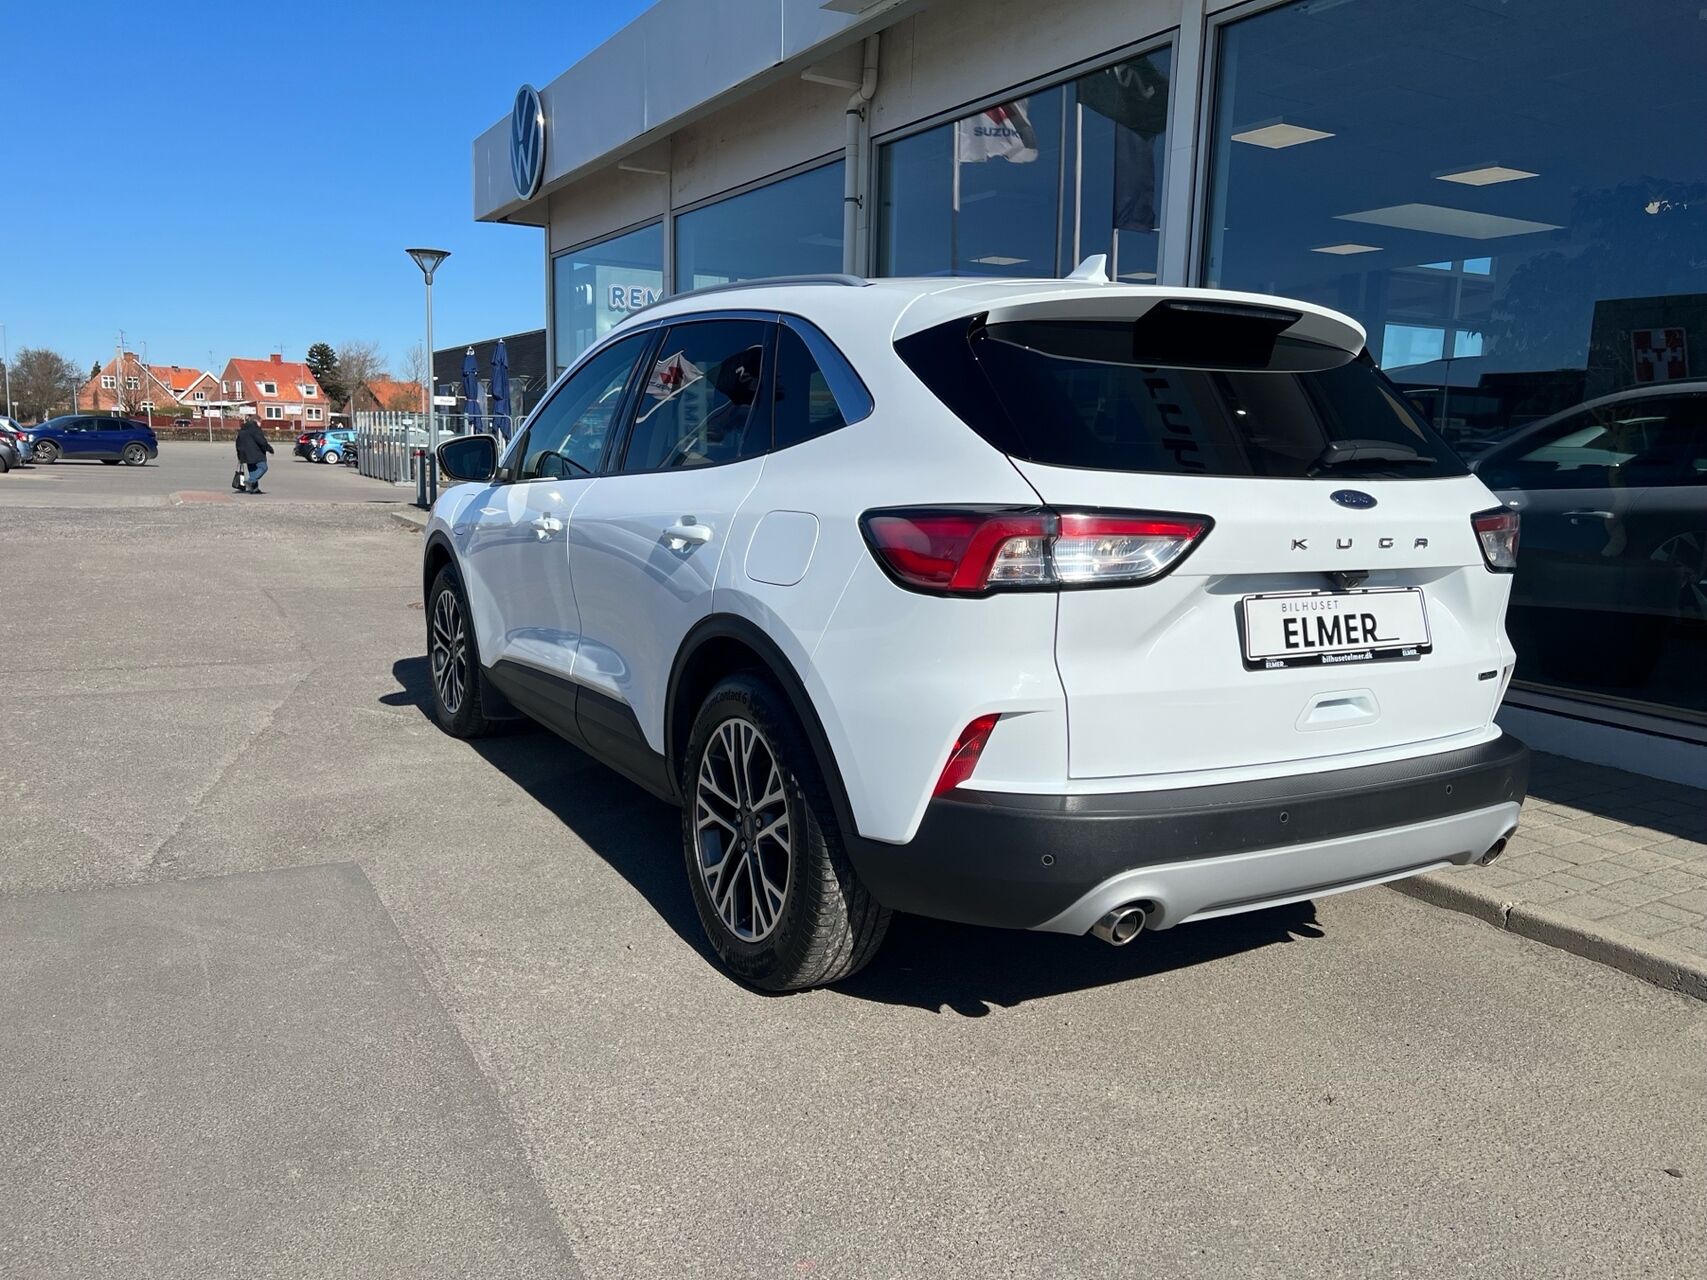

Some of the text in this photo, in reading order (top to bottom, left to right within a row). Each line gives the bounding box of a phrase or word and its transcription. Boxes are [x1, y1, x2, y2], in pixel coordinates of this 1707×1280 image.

[974, 126, 1021, 139] SUZUK
[1290, 537, 1429, 551] KUGA
[1281, 600, 1339, 613] BILHUSET
[1282, 613, 1400, 649] ELMER
[1322, 652, 1372, 663] bilhusetelmer.dk
